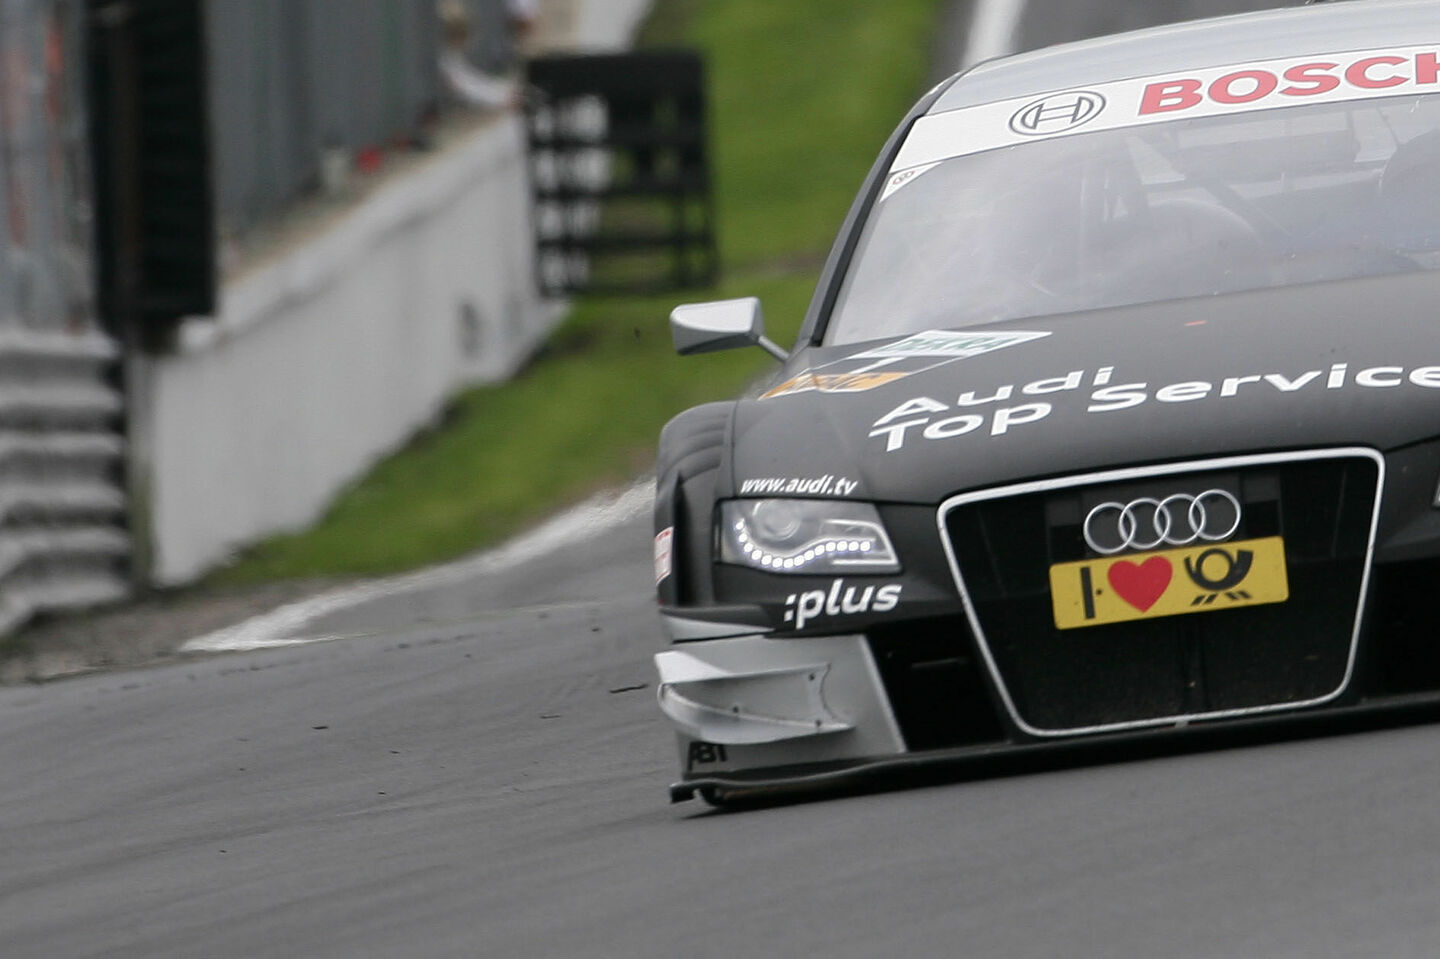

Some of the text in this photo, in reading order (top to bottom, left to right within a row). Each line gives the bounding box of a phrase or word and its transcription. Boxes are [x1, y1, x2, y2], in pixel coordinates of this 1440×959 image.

[872, 366, 1114, 427] Audi
[868, 402, 1052, 452] Top
[740, 474, 858, 495] www.audi.tv
[784, 578, 902, 630] :plus
